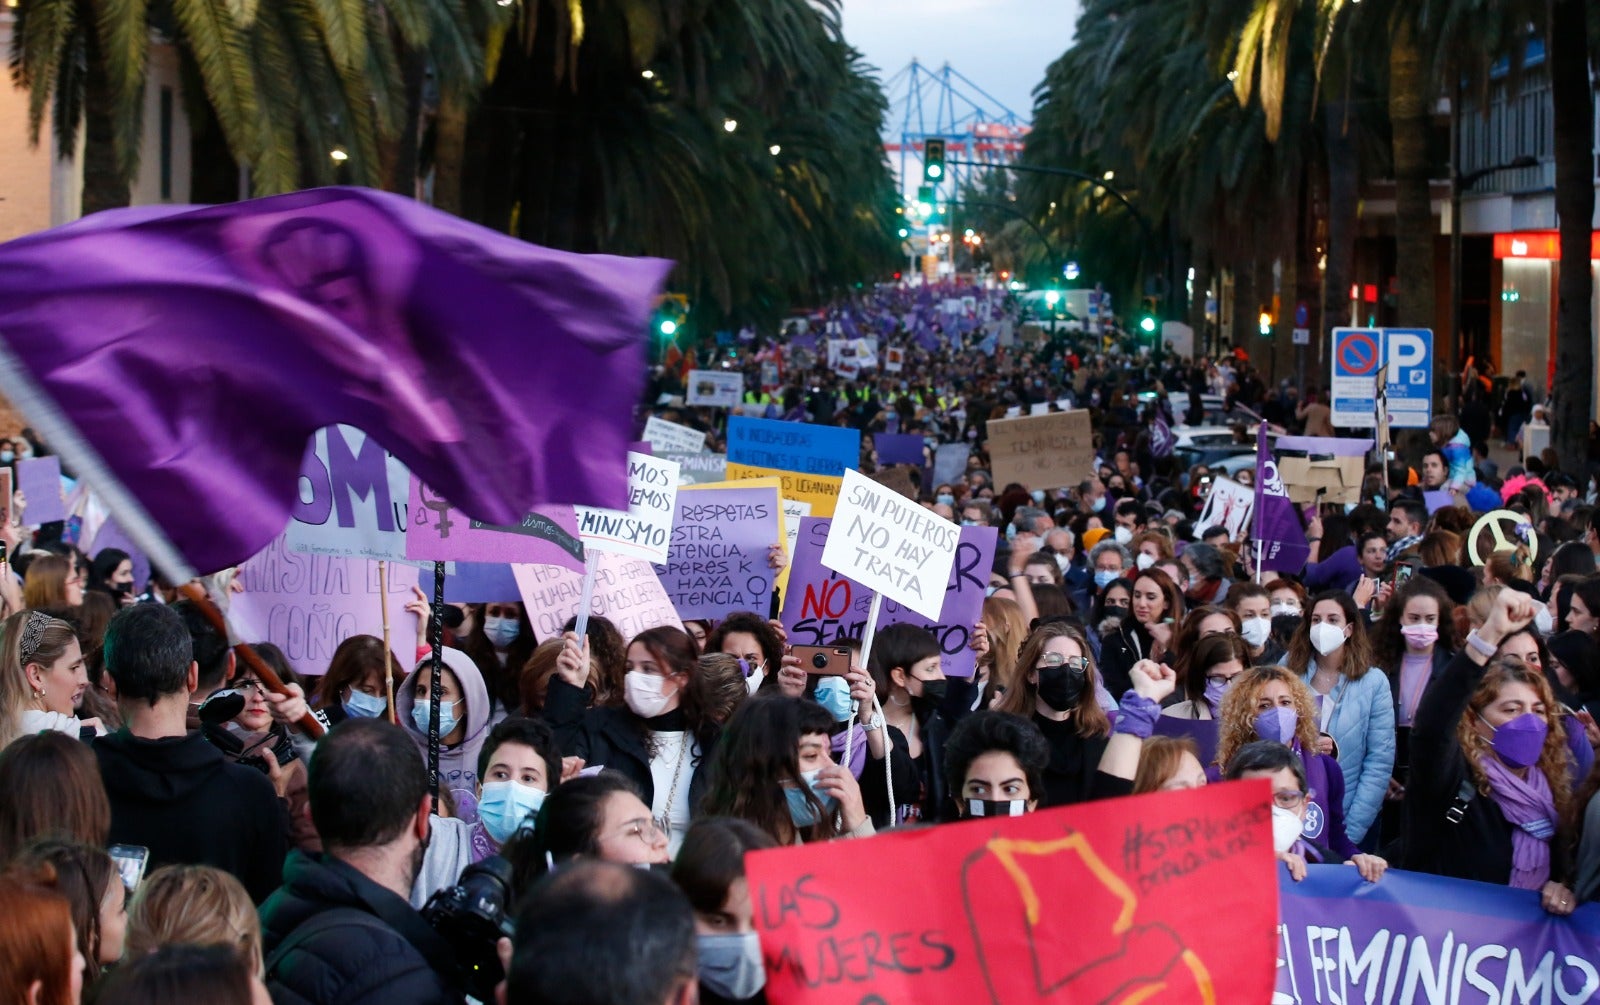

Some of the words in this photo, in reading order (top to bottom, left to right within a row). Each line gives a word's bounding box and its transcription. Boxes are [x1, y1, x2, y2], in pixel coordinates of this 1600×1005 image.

[1388, 333, 1426, 384] P
[576, 510, 666, 546] MINISMO
[847, 484, 876, 515] SIN
[883, 498, 958, 553] PUTEROS
[847, 515, 890, 549] NO
[895, 539, 934, 570] HAY
[678, 575, 733, 590] HAYA
[739, 560, 753, 574] K
[854, 546, 924, 601] TRATA
[801, 579, 851, 620] NO
[854, 595, 872, 613] ES
[268, 603, 357, 660] COÑO
[759, 873, 841, 930] LAS
[765, 930, 956, 990] MUJERES
[1306, 923, 1600, 1005] FEMINISMO
